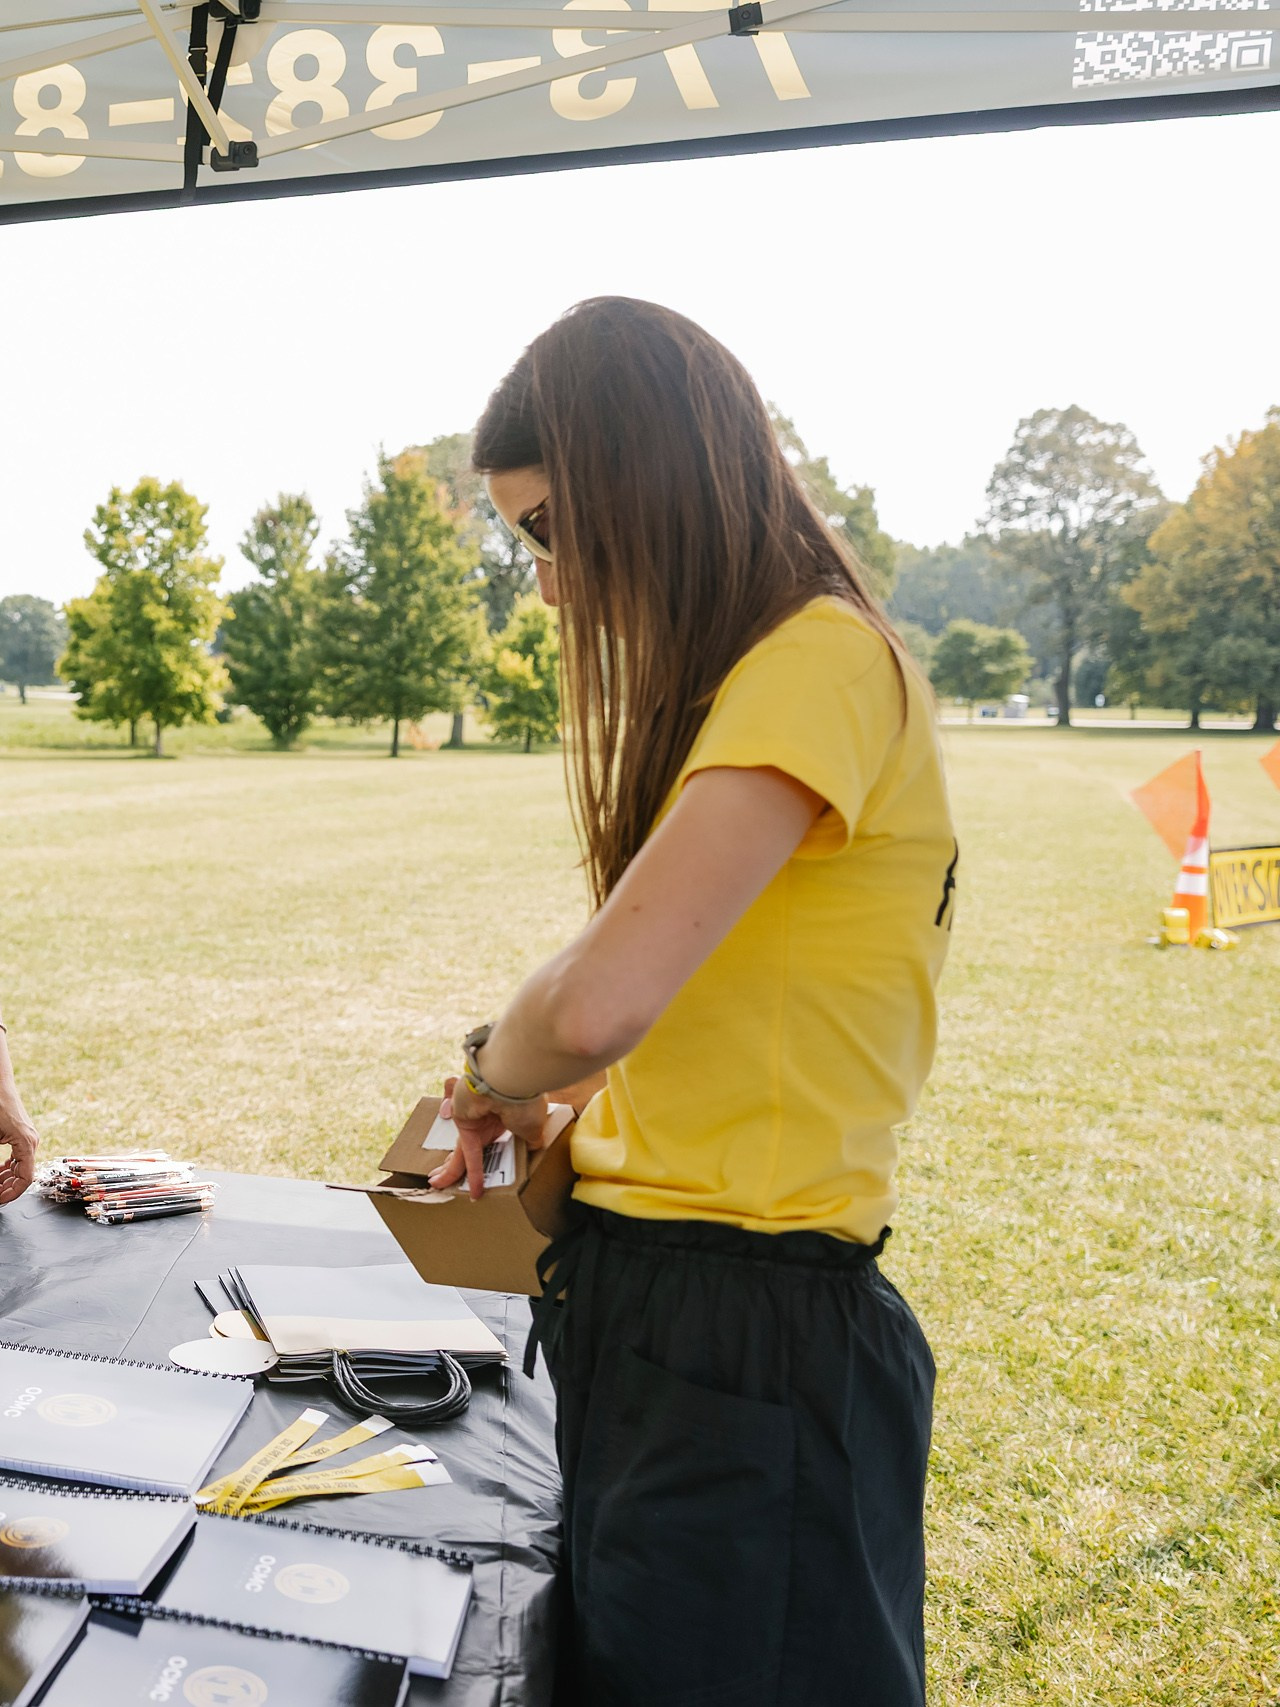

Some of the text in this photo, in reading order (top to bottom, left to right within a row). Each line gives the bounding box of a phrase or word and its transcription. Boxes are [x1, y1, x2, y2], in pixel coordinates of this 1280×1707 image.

[3, 1386, 43, 1418] OCMC
[245, 1555, 277, 1593] OCMC
[148, 1655, 188, 1703] OCMC
